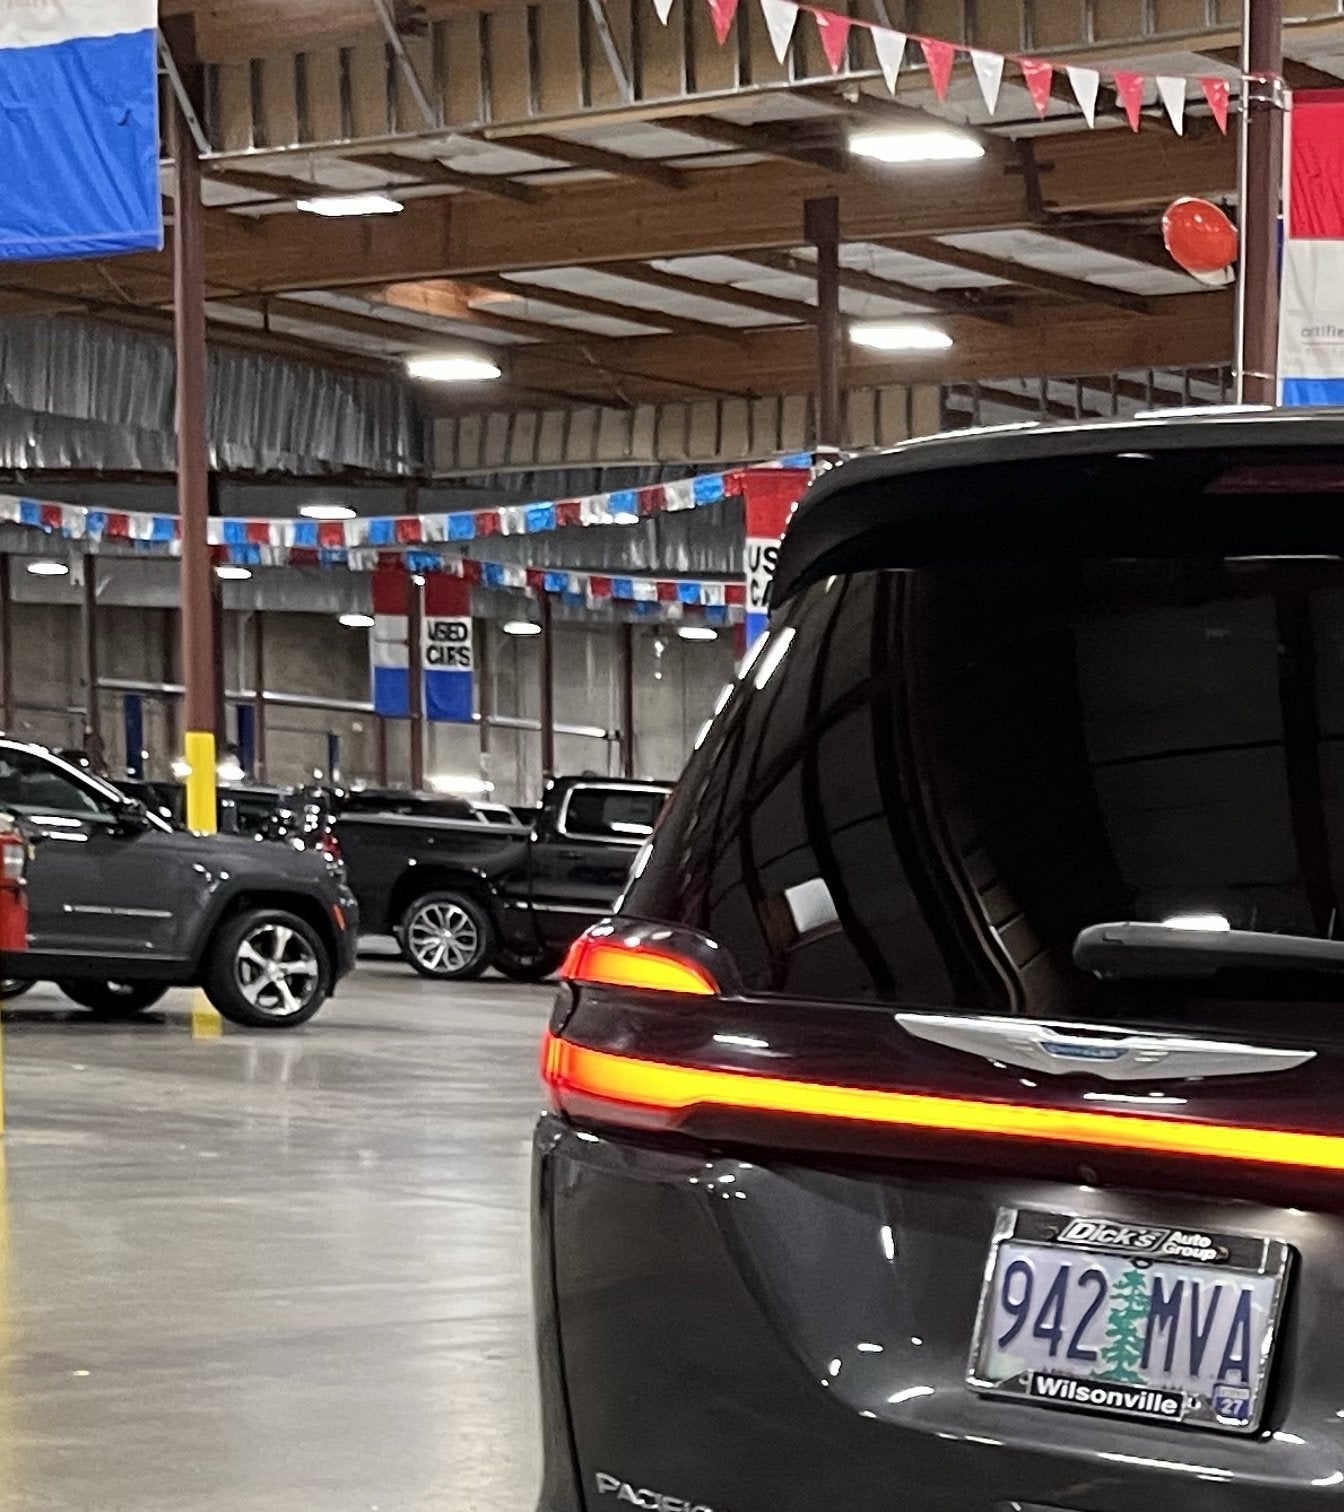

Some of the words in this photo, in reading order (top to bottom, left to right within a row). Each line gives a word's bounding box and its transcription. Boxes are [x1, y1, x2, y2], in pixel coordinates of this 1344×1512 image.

[749, 546, 780, 573] US
[427, 620, 469, 642] USED
[1162, 1240, 1217, 1262] Group
[1170, 1231, 1213, 1249] Auto
[998, 1260, 1109, 1361] 942
[1140, 1274, 1253, 1383] MVA
[1035, 1375, 1179, 1415] Wilsonville
[1220, 1398, 1244, 1416] 27
